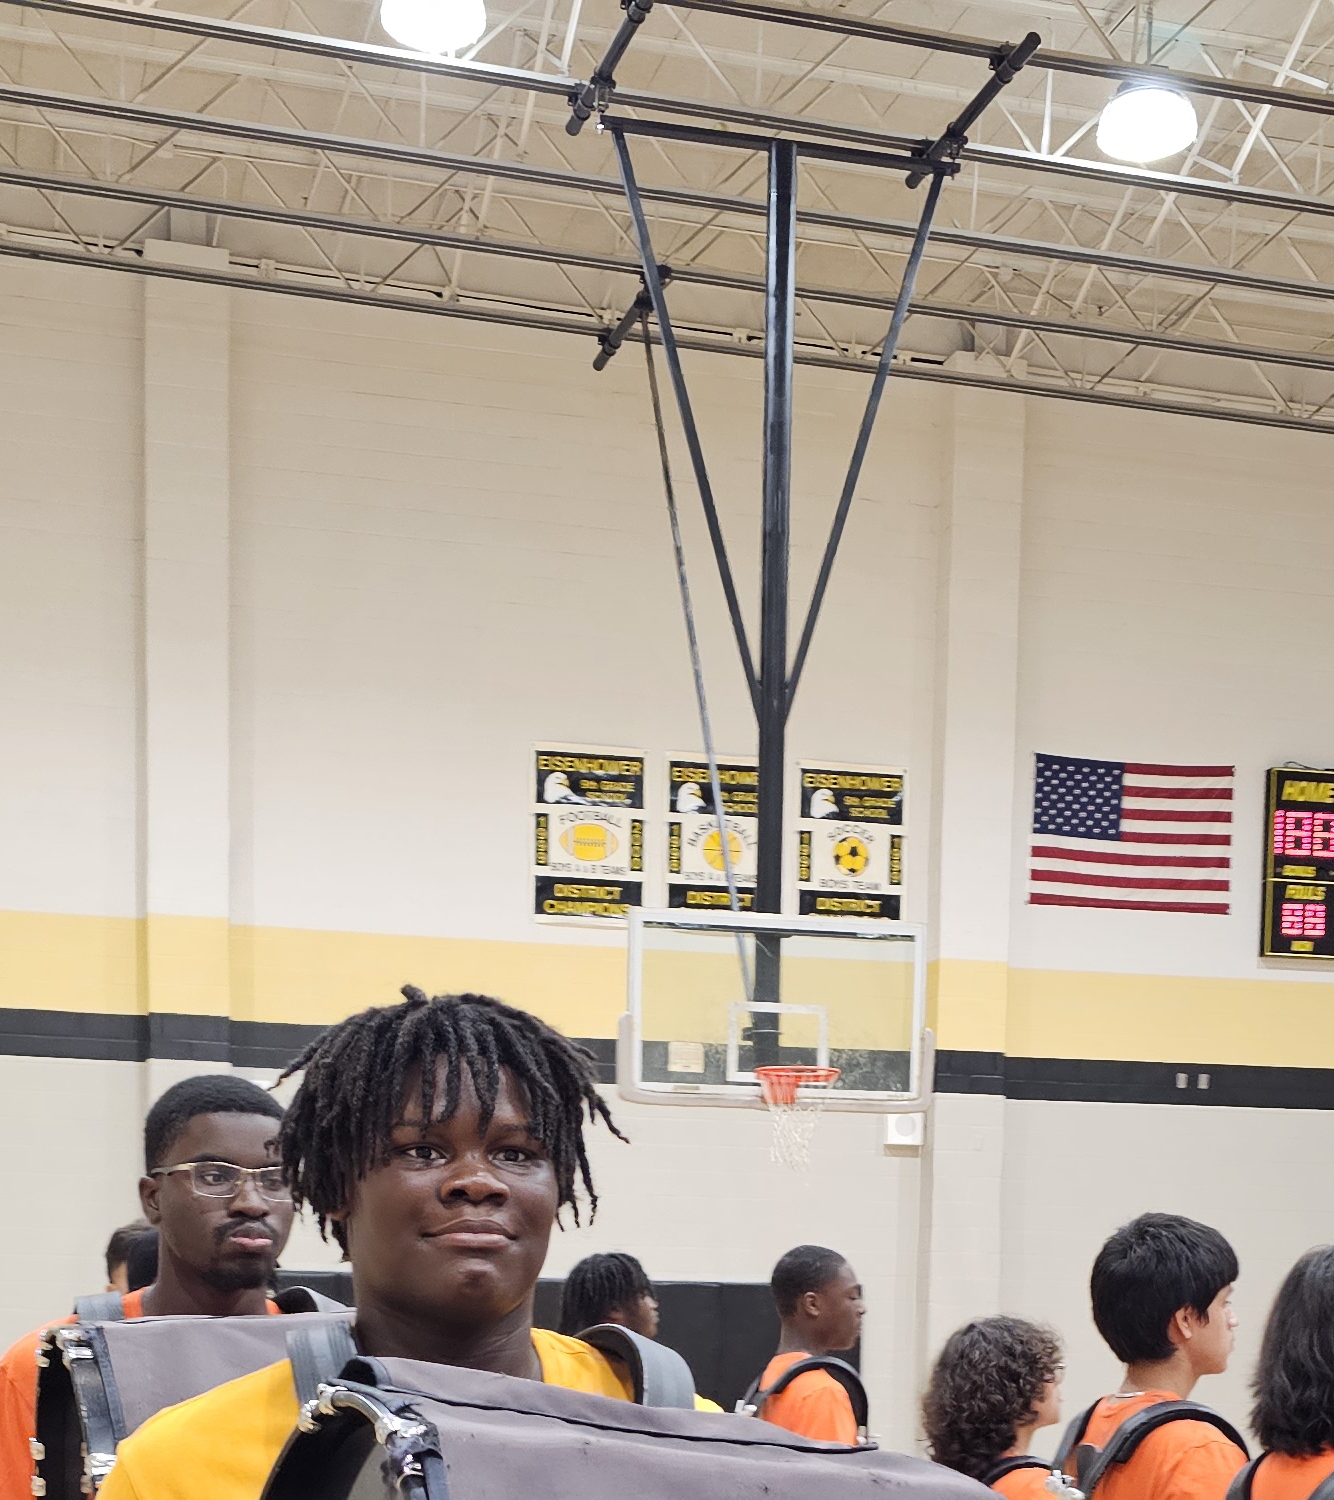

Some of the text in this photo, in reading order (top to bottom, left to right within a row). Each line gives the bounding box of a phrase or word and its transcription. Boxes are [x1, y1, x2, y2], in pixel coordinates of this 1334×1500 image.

[538, 756, 643, 776] EISENHOWER
[601, 781, 636, 793] GRADE
[804, 774, 903, 791] EISENHOWER
[586, 791, 632, 804] SCHOOL
[863, 797, 896, 808] GRADE
[560, 810, 623, 829] FOOTBALL
[849, 808, 890, 819] SCHOOL
[827, 824, 876, 845] SOCCER
[554, 884, 623, 900] DISTRICT
[820, 879, 881, 891] BOYS TEAM
[1286, 885, 1327, 900] FOULS
[817, 897, 883, 913] DISTRICT
